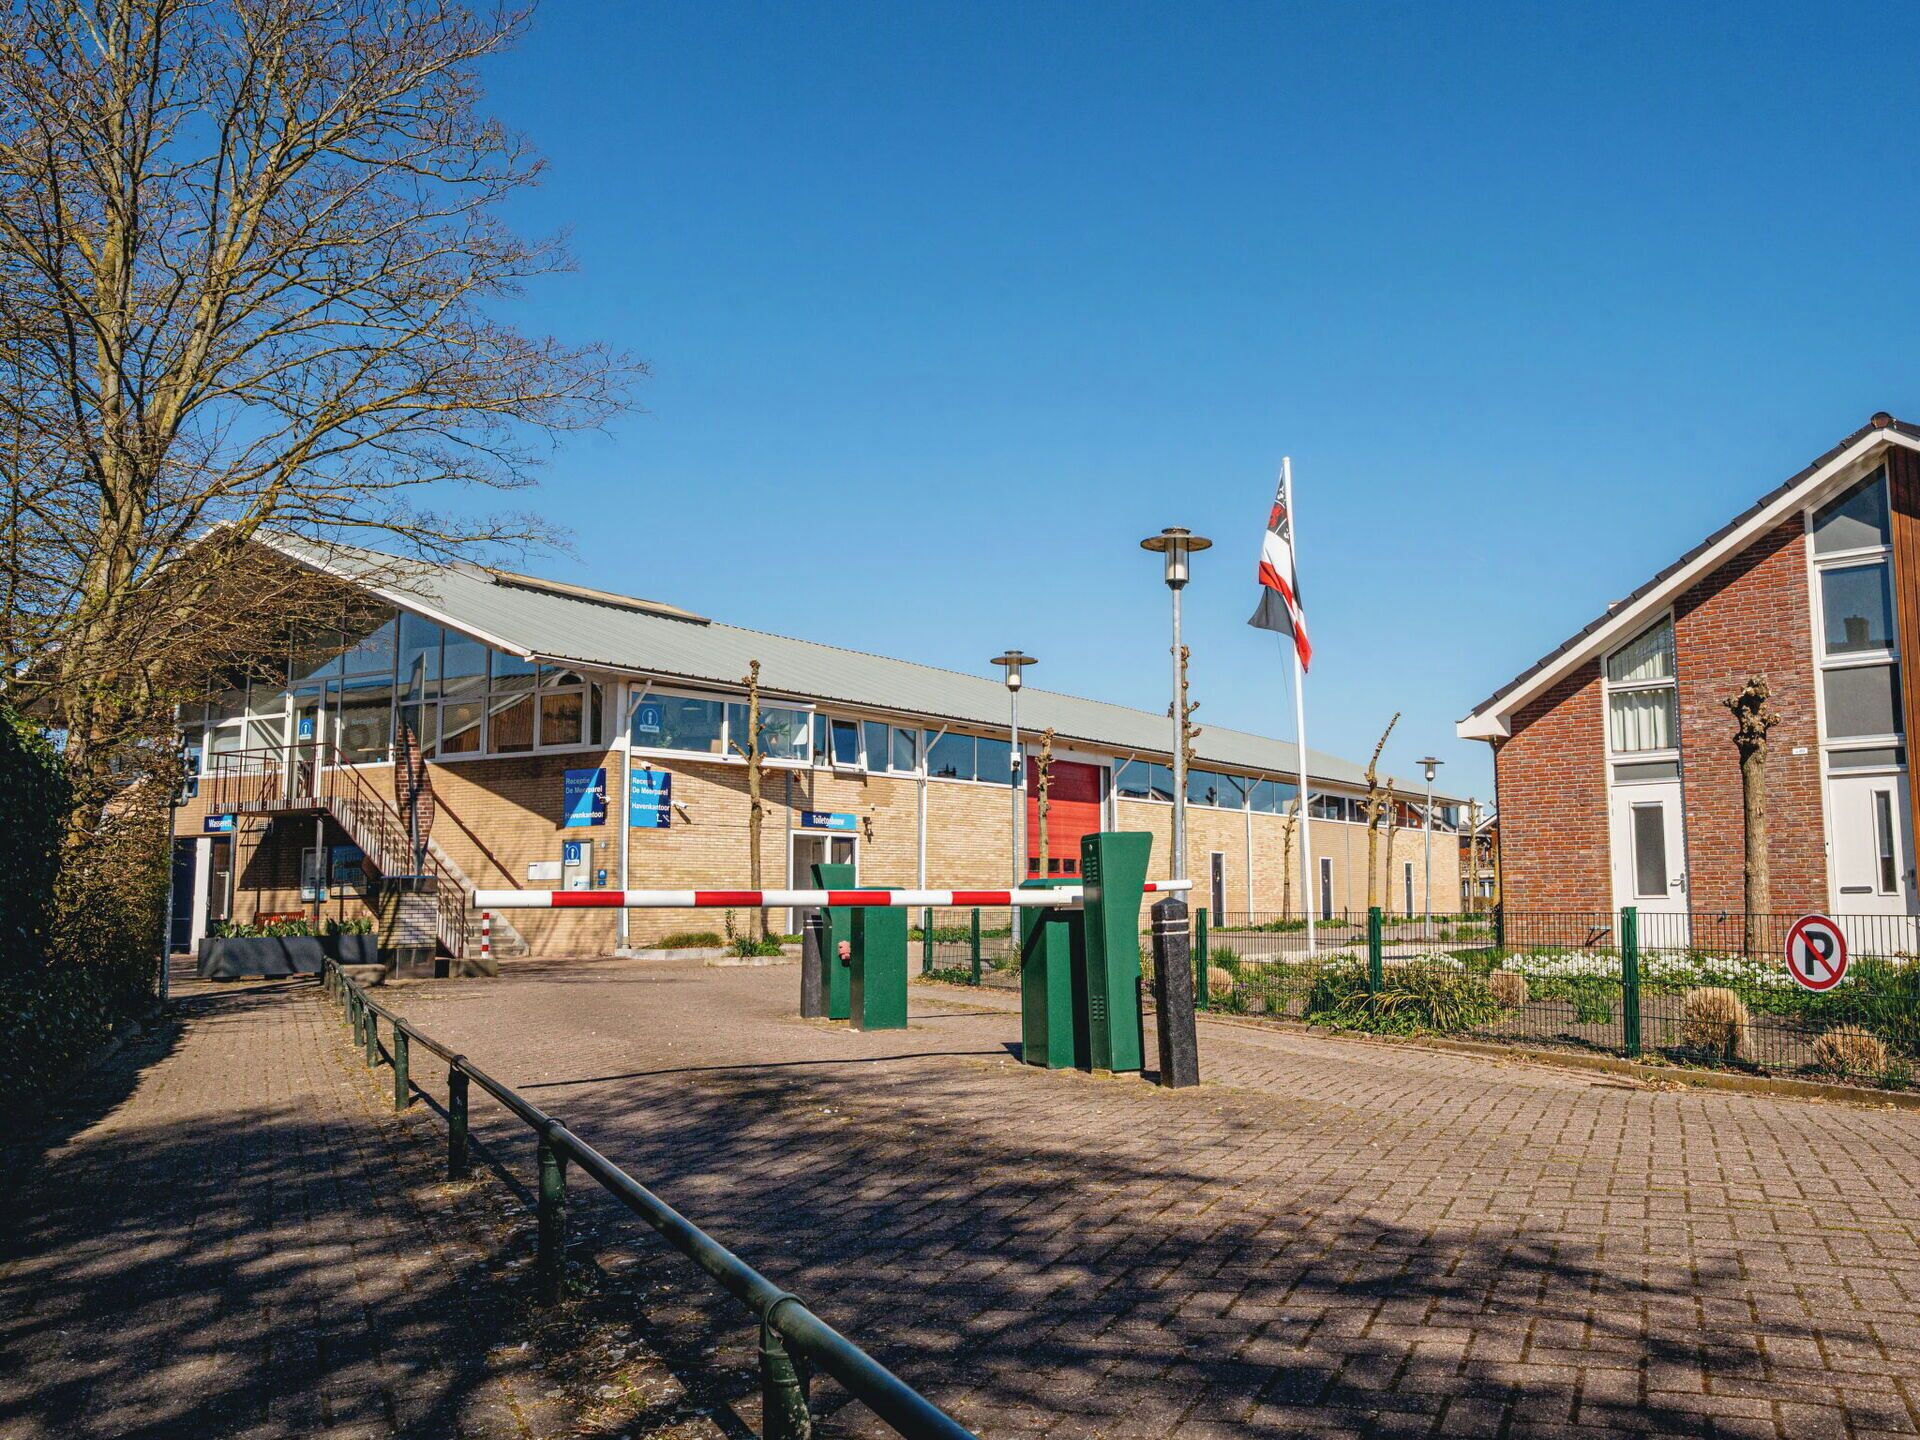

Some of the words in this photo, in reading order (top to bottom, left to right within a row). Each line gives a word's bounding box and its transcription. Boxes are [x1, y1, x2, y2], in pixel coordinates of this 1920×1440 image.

[632, 786, 640, 794] De
[631, 802, 670, 811] Havenkantoor
[564, 811, 604, 819] Havenkantoor
